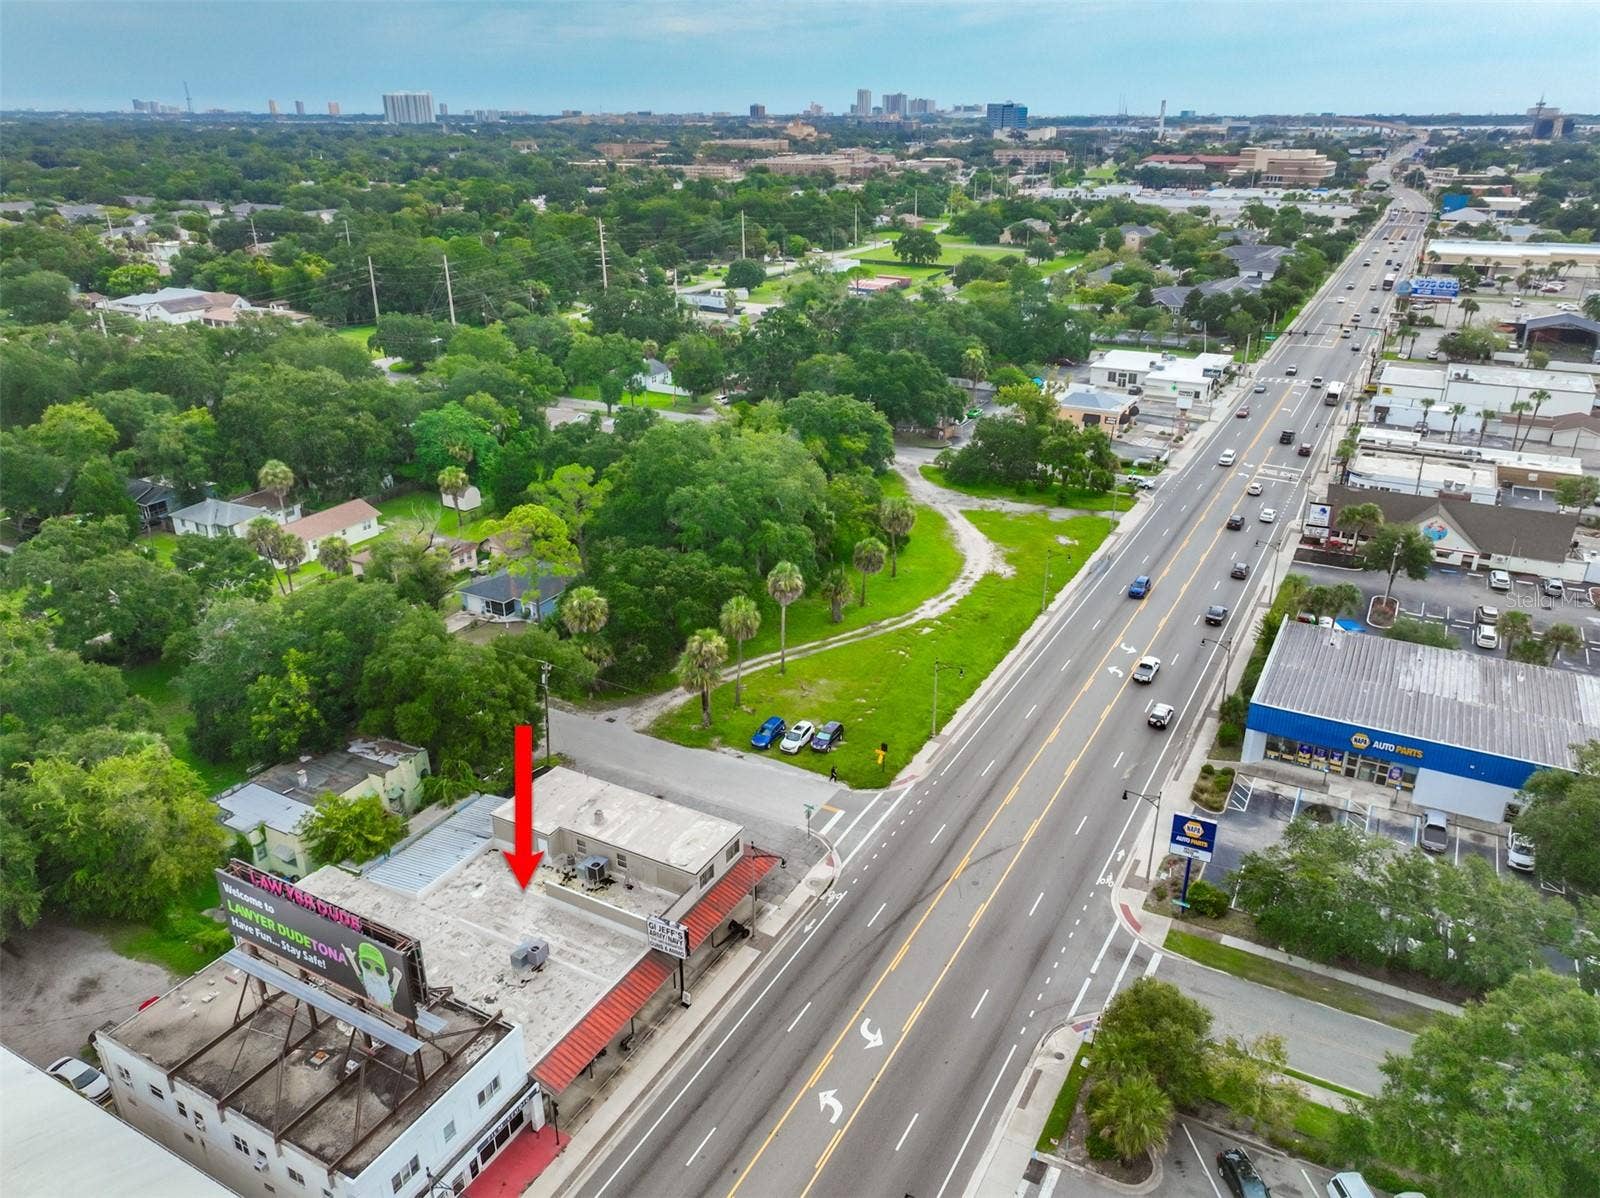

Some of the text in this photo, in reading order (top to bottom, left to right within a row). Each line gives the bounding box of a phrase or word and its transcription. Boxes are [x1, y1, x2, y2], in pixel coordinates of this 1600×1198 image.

[1372, 741, 1395, 752] AUTO
[1395, 745, 1424, 759] PARTS
[1186, 825, 1201, 834] NAPA
[222, 881, 275, 914] Welcome to
[250, 870, 362, 933] LAWYER DUDE
[227, 898, 348, 967] LAWYER DUDETONA
[231, 916, 327, 969] Have Fun... Stay Safe!
[658, 925, 683, 940] JEFF'S
